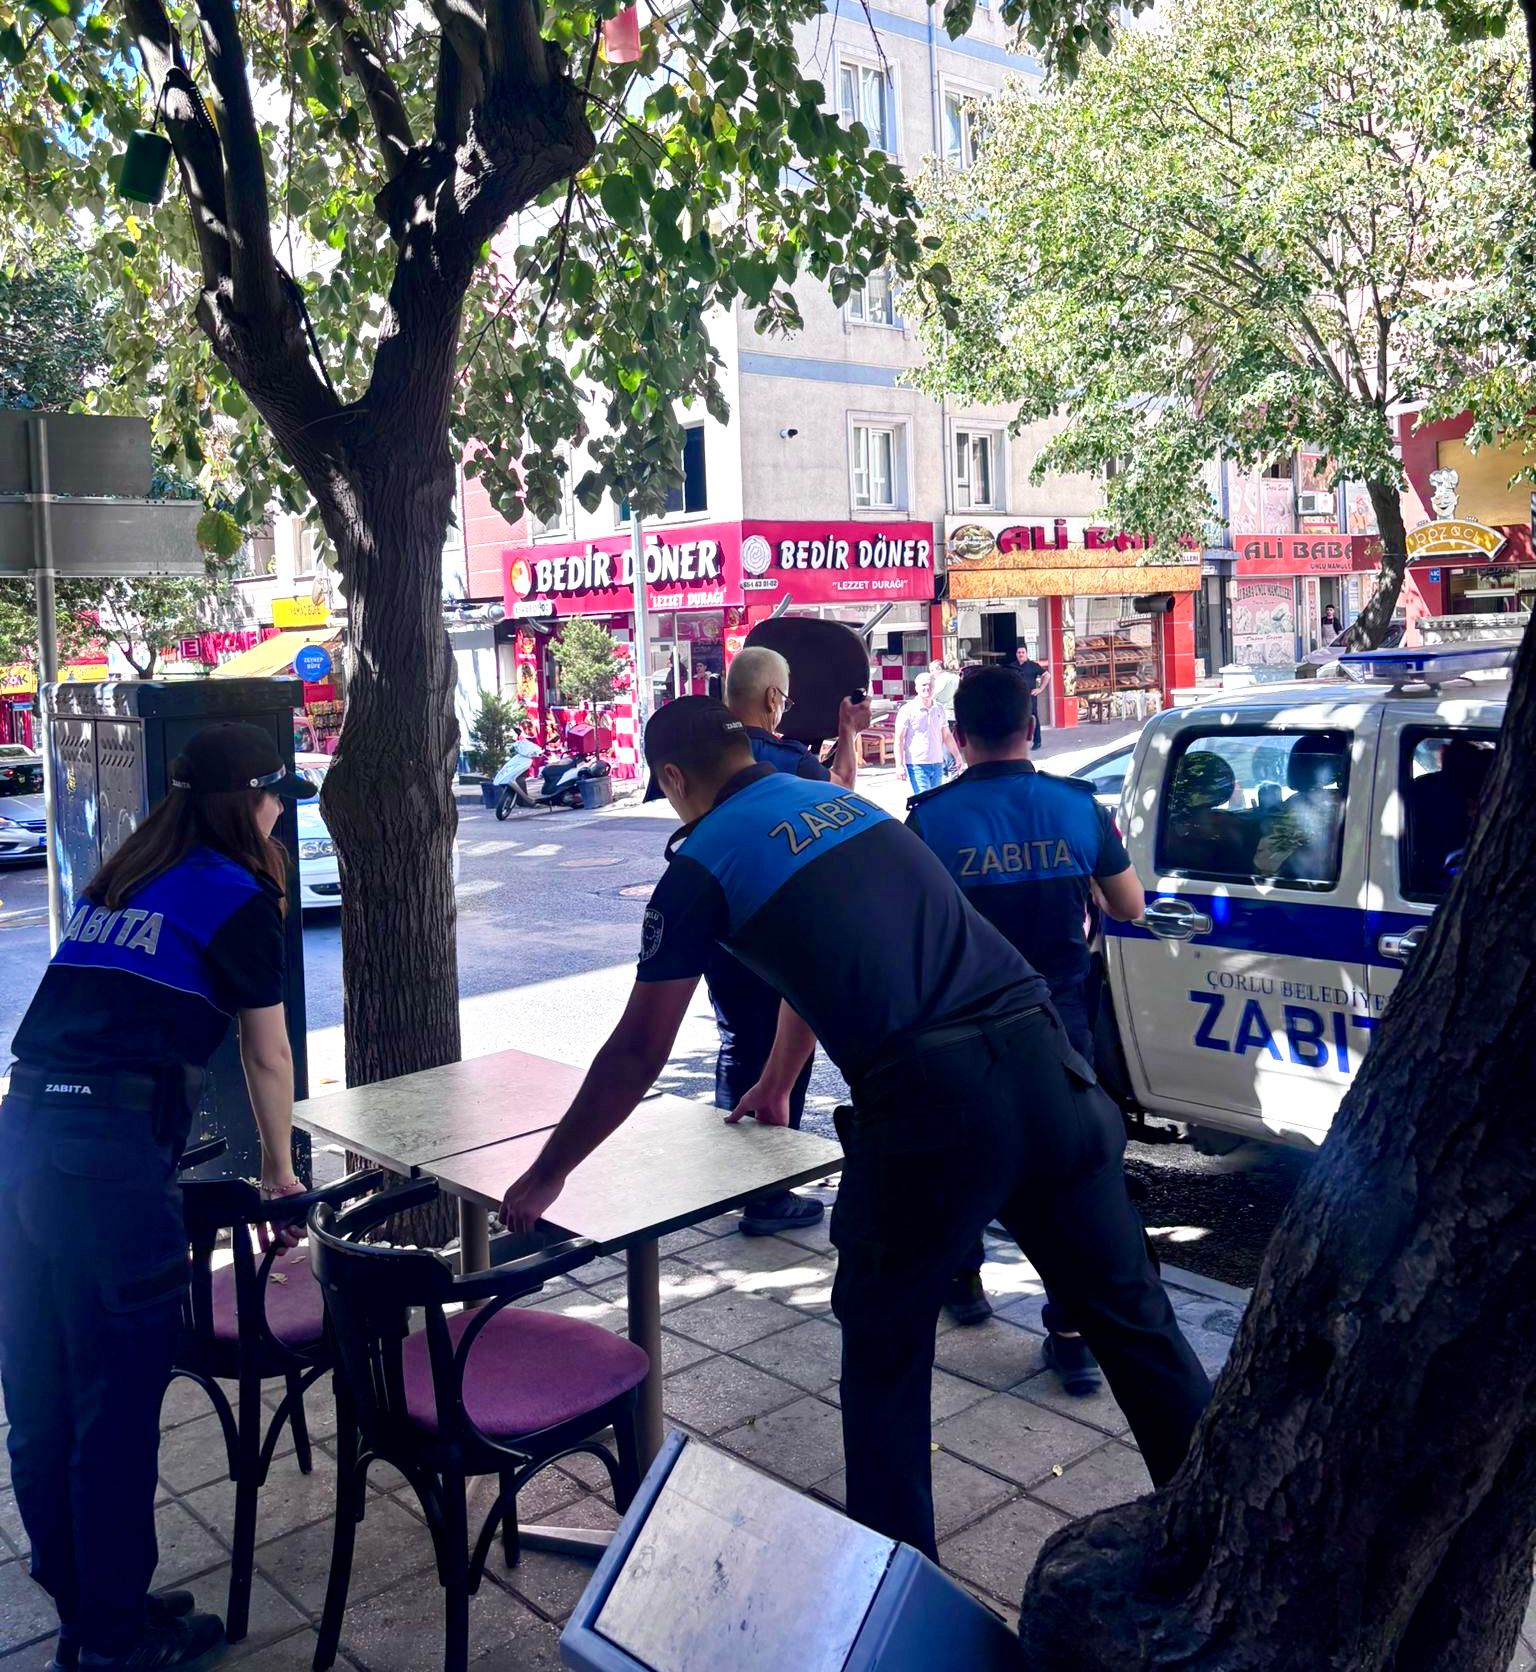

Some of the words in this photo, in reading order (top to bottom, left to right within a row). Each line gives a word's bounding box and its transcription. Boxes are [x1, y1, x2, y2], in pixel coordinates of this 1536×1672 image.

[780, 534, 849, 570] BEDİR
[859, 533, 930, 570] DÖNER
[996, 518, 1069, 554] ALİ
[1244, 538, 1283, 560] ALİ
[535, 544, 614, 592] BEDİR
[621, 535, 720, 585] DÖNER
[768, 792, 881, 855] ZABIT
[958, 839, 1074, 877] ZABITA
[64, 904, 164, 955] ABITA
[1206, 970, 1275, 995] ÇORLU
[1281, 980, 1389, 1011] BELEDİYE
[44, 1083, 92, 1095] ZABITA
